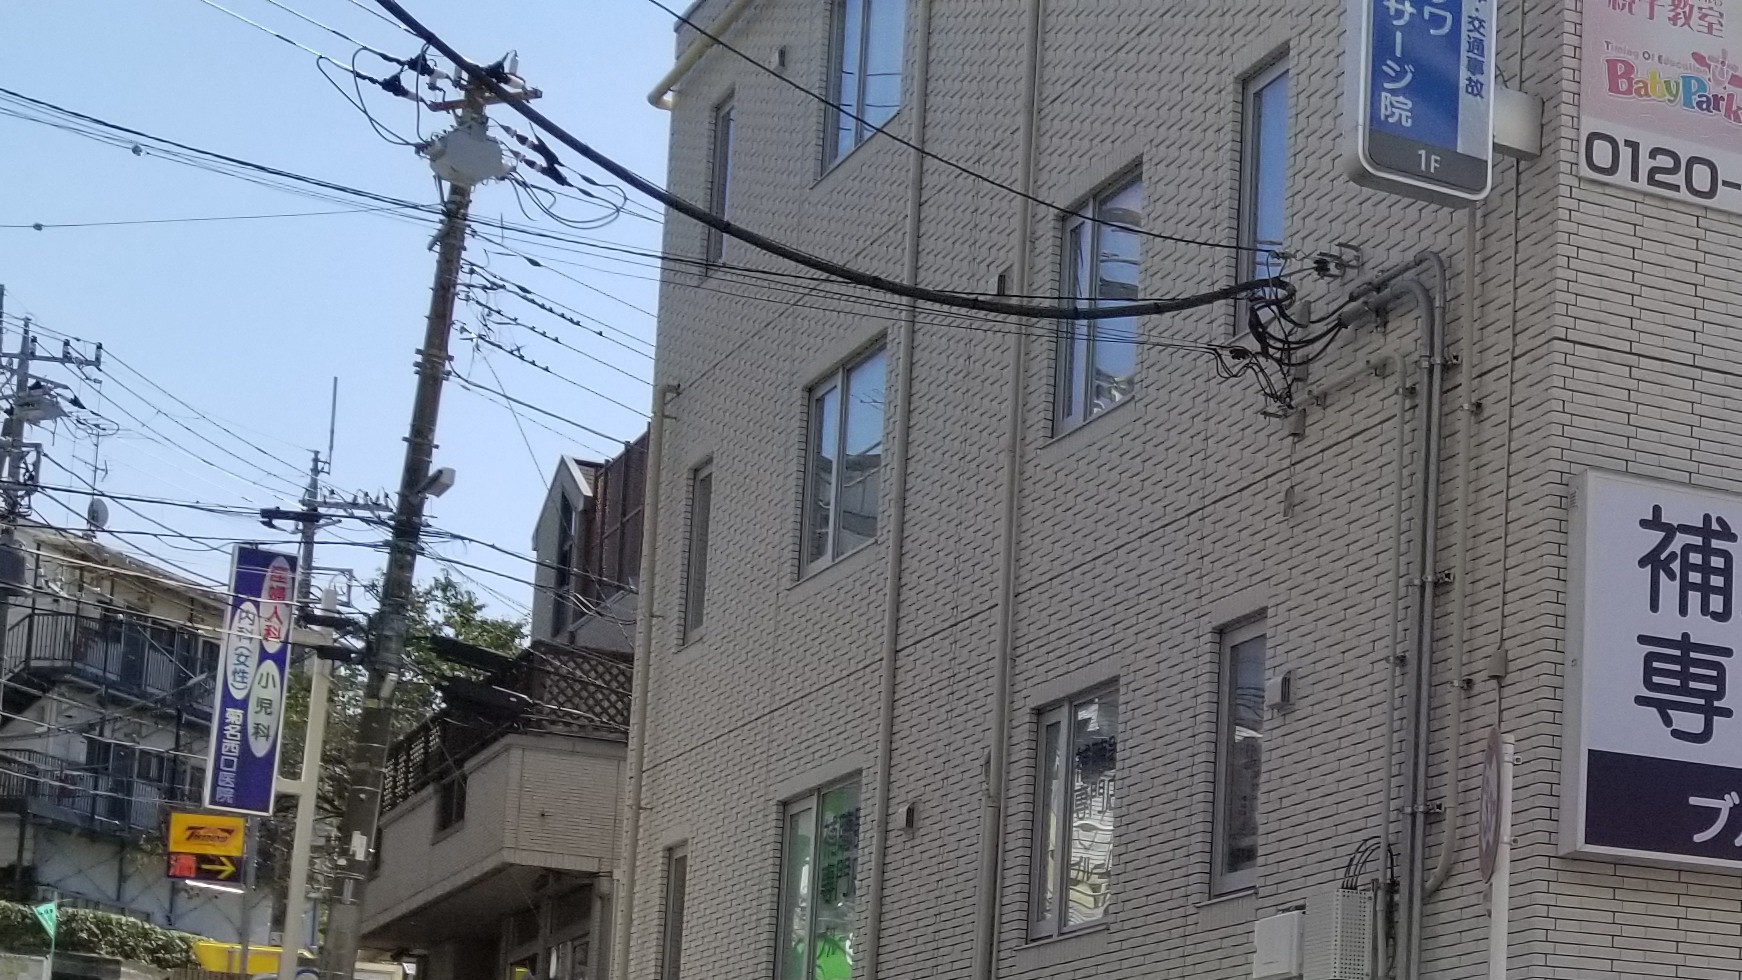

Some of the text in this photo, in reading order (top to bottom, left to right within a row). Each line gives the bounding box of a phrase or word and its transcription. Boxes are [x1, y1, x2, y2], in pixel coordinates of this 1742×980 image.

[1465, 0, 1488, 99] ・交通事故
[1417, 149, 1441, 174] 1F
[252, 671, 278, 743] 小児科
